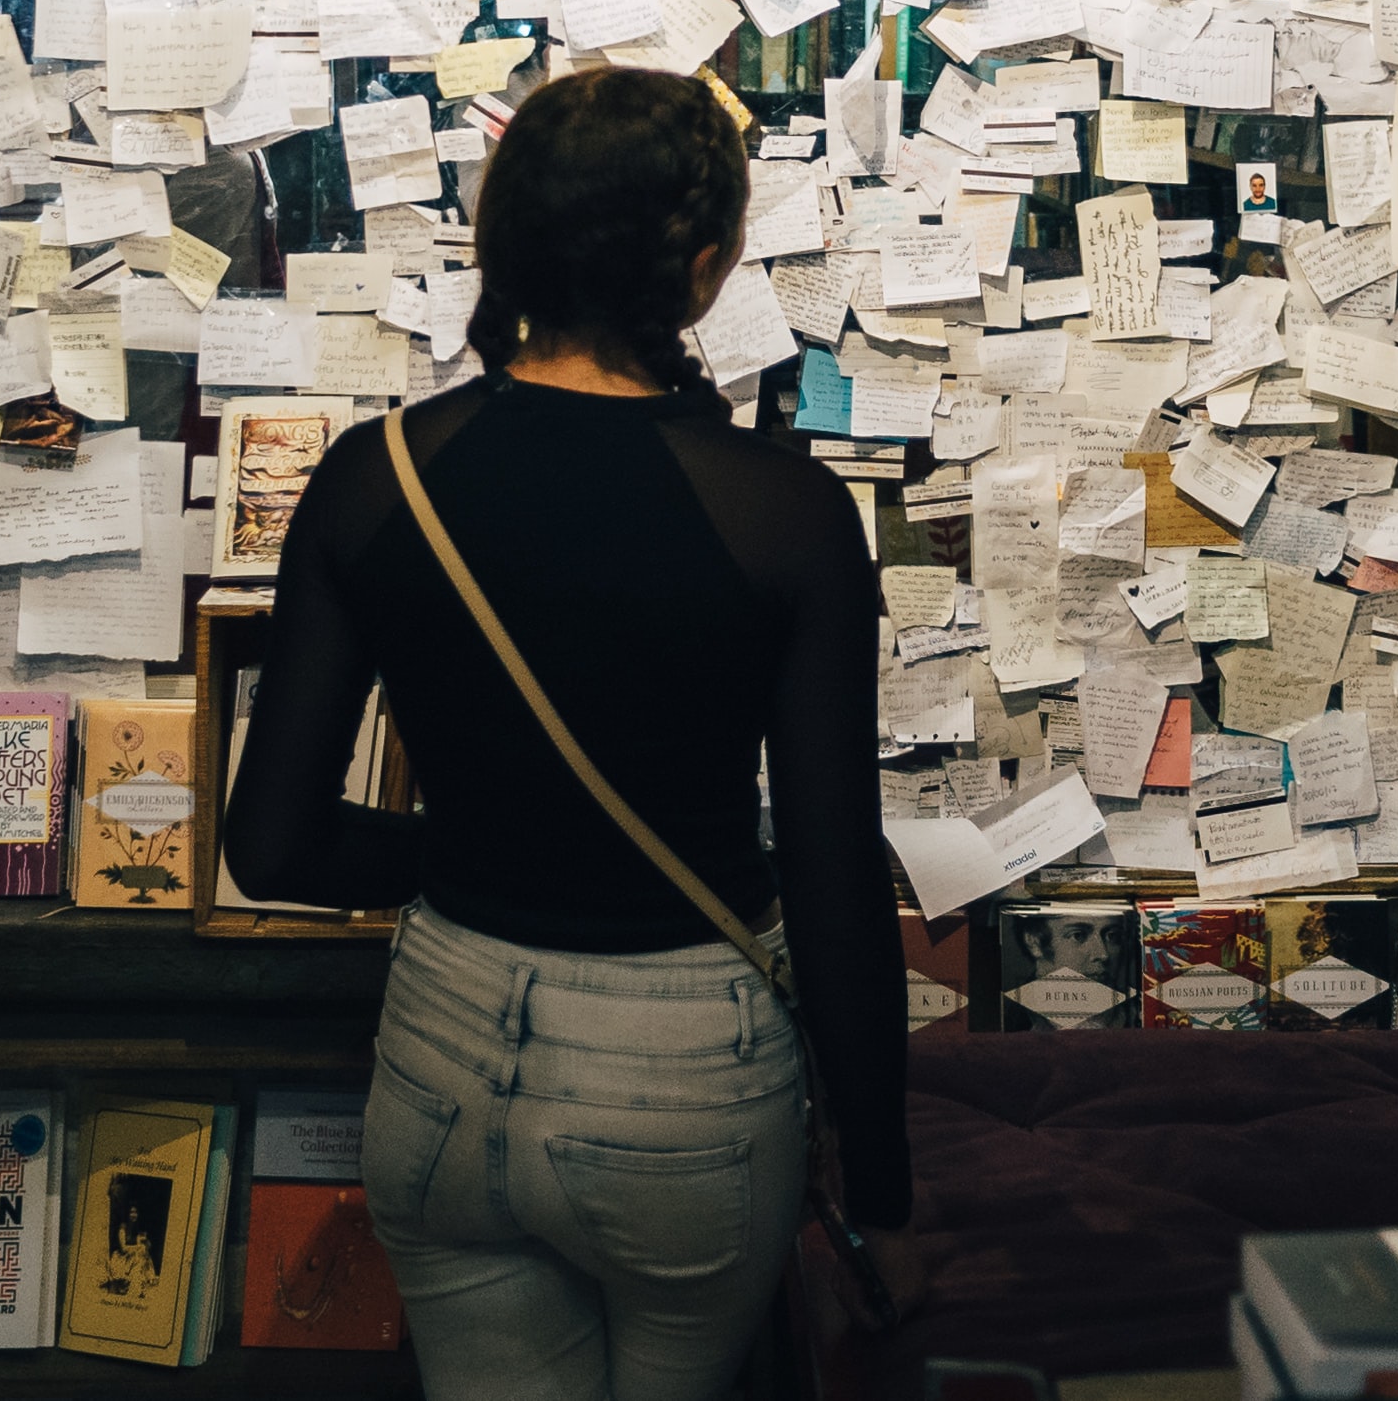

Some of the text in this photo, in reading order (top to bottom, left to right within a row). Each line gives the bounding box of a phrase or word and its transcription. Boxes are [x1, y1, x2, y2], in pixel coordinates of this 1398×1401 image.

[12, 720, 48, 731] MARIA
[106, 794, 193, 807] EMILY DICKINSON
[19, 806, 38, 814] AND
[1, 822, 11, 830] BY
[4, 829, 44, 839] MITCHELL
[1292, 979, 1367, 992] SOLITUDE
[1044, 990, 1088, 1002] BURNS
[1168, 986, 1213, 999] RUSSIAN
[314, 1125, 342, 1139] Blue
